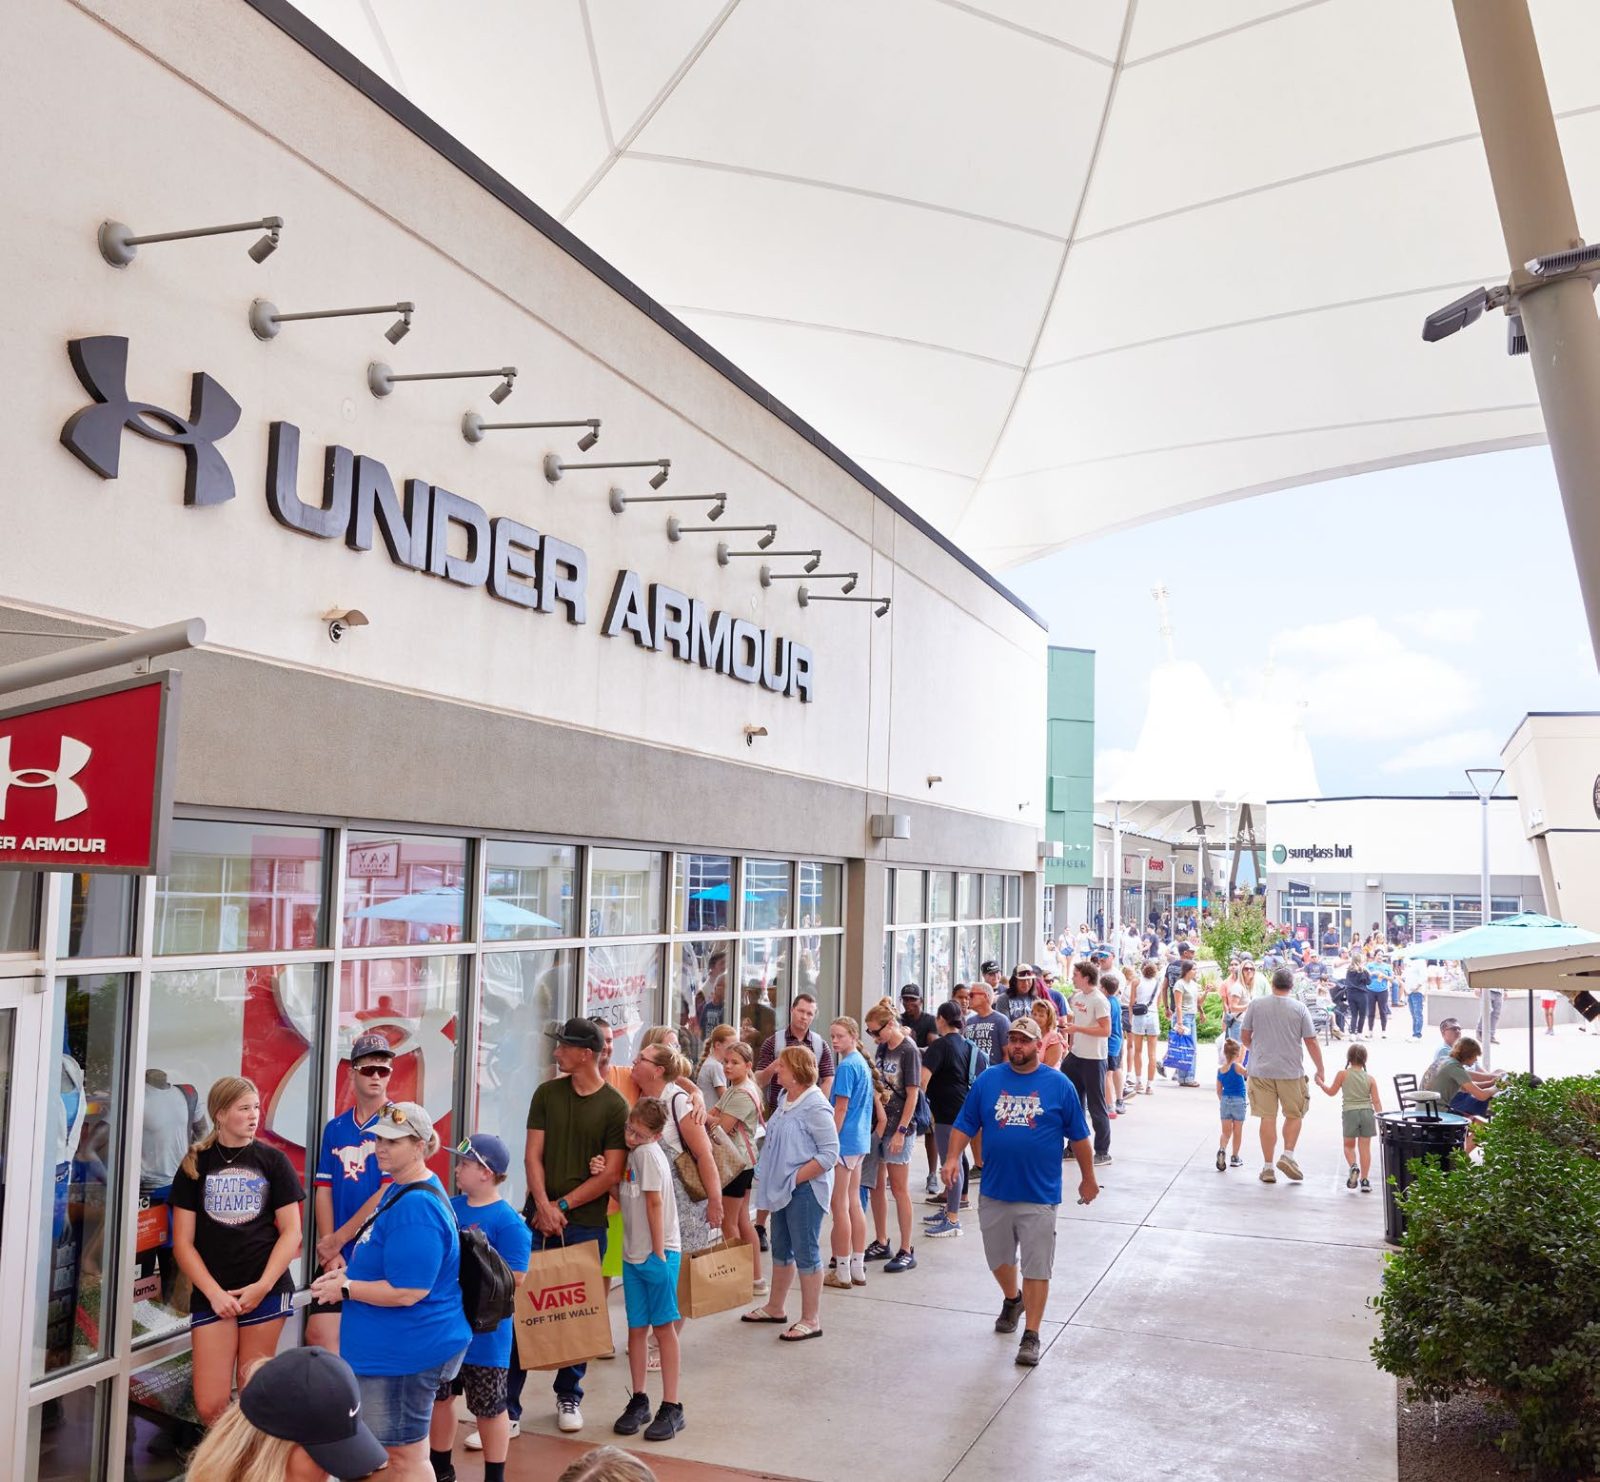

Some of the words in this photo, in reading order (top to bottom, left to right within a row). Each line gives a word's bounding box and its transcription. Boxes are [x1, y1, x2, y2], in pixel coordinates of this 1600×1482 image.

[265, 420, 588, 626] UNDER
[600, 568, 815, 704] ARMOUR
[21, 836, 106, 854] ARMOUR
[1288, 843, 1334, 863] sunglass
[1334, 843, 1353, 859] hut
[975, 1022, 996, 1031] MORE
[205, 1177, 247, 1194] STATE
[204, 1193, 262, 1212] CHAMPS
[527, 1281, 587, 1312] VANS
[547, 1312, 567, 1323] THE
